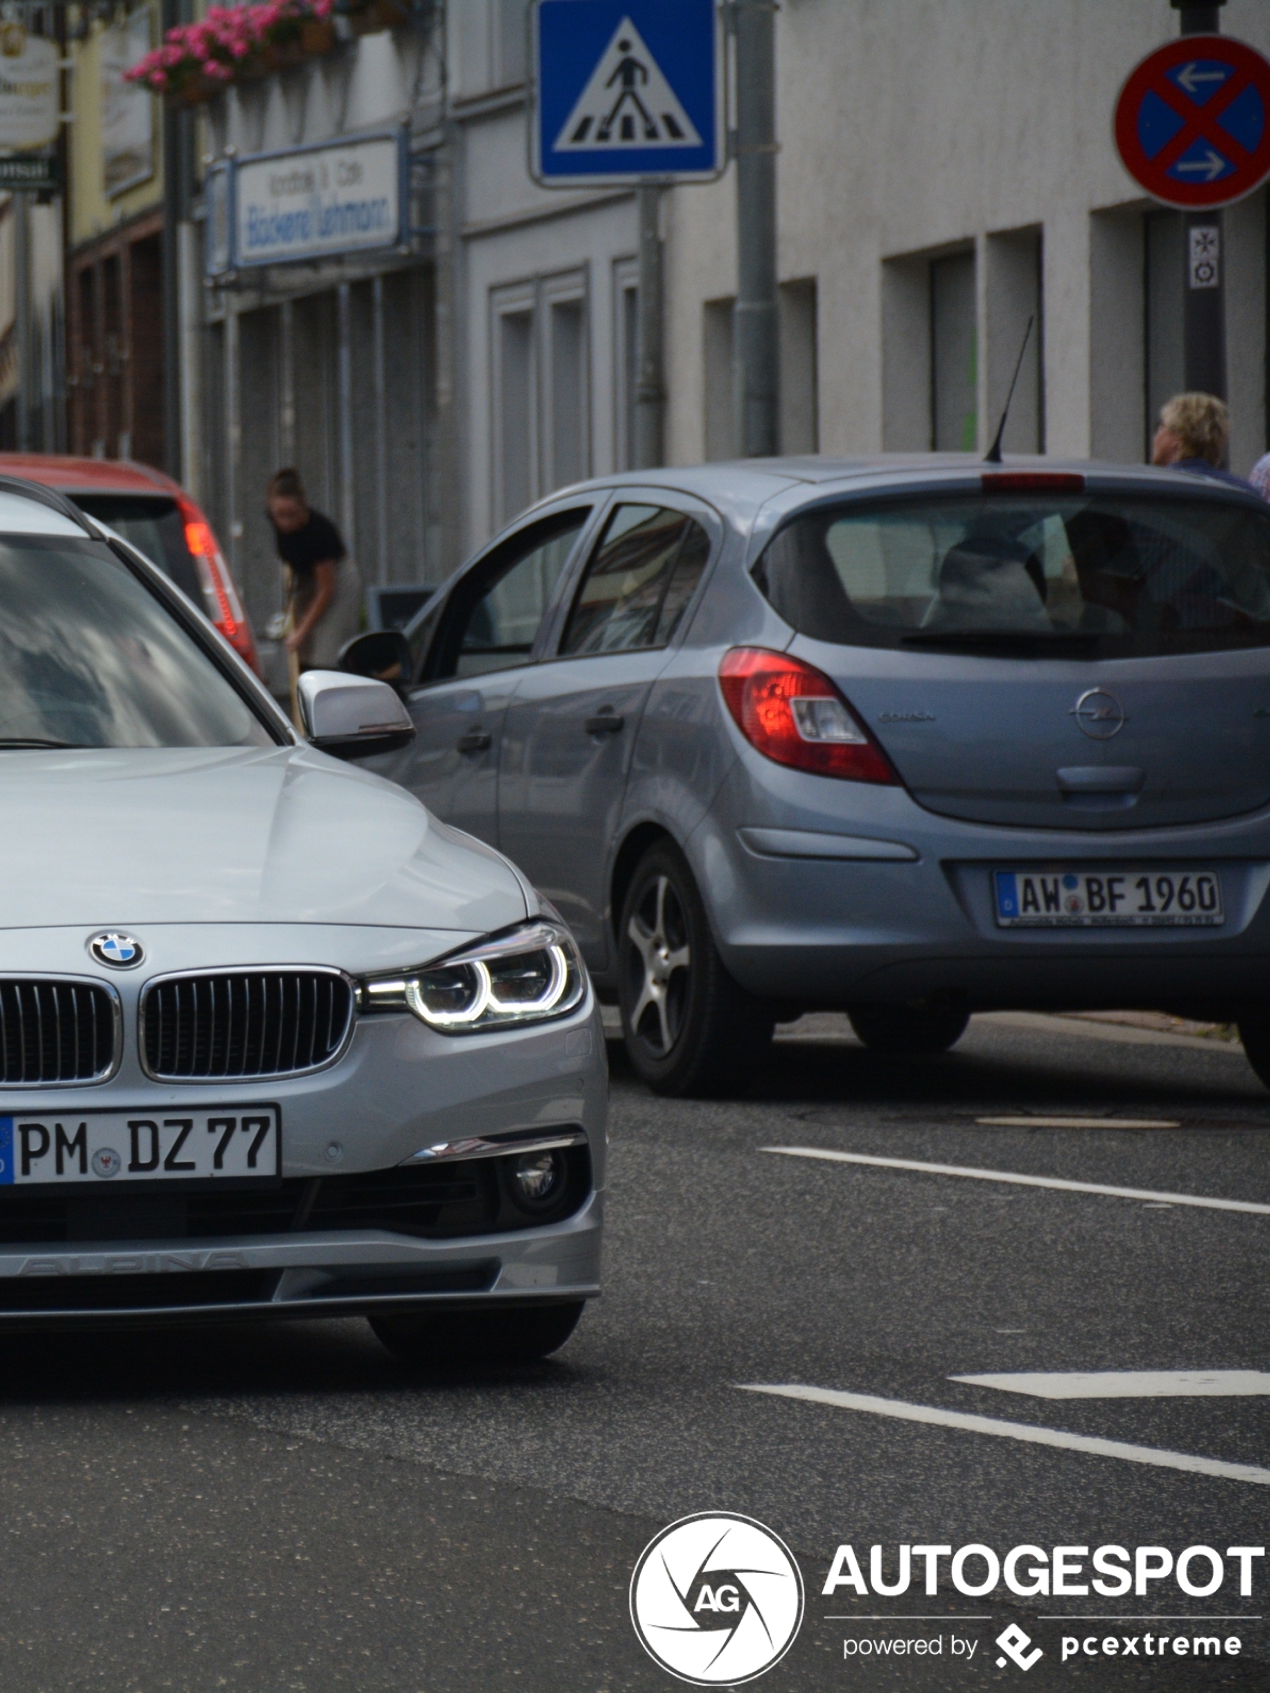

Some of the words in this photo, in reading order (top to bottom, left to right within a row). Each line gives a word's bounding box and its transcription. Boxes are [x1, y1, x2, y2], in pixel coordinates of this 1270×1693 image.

[1022, 878, 1061, 913] AW
[1085, 877, 1125, 912] BF
[1135, 876, 1217, 912] 1960
[92, 933, 138, 947] BMW
[18, 1122, 88, 1177] PM
[127, 1118, 197, 1173] DZ
[207, 1115, 271, 1170] 77
[17, 1251, 250, 1276] ALPINA
